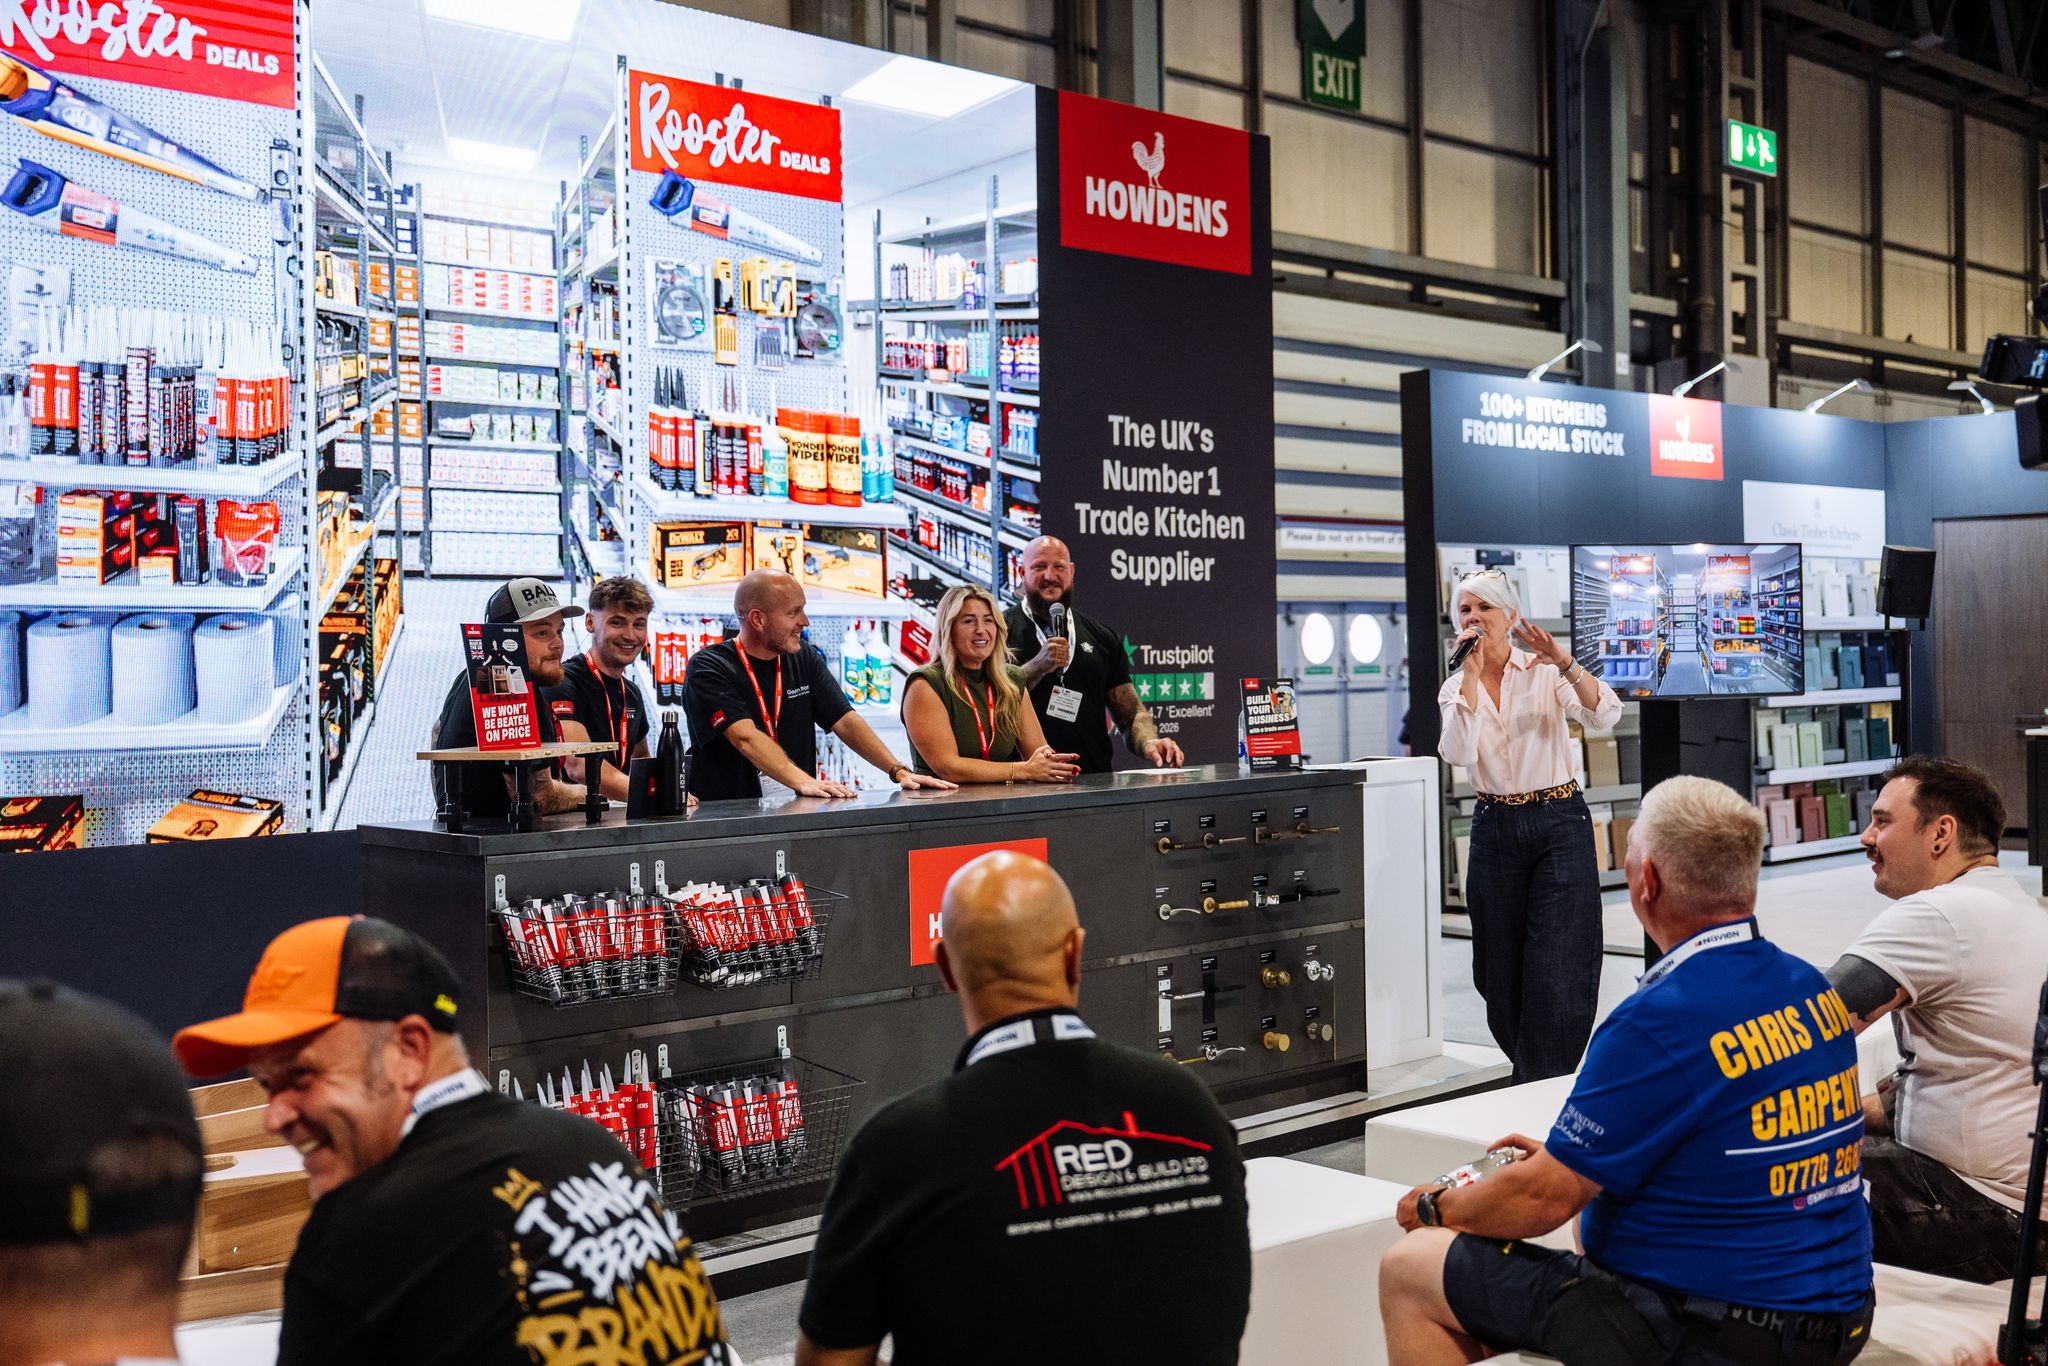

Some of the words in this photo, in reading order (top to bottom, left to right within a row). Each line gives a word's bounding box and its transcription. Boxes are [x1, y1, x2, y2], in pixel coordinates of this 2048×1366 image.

[206, 43, 280, 76] DEALS
[1312, 51, 1357, 102] EXIT
[639, 81, 781, 169] Rooster
[780, 150, 831, 175] DEALS
[1085, 176, 1229, 238] HOWDENS
[1480, 391, 1524, 419] 100+
[1525, 396, 1607, 429] KITCHENS
[1108, 414, 1157, 449] The
[1160, 421, 1214, 453] UK's
[1462, 418, 1513, 448] FROM
[1515, 424, 1570, 452] LOCAL
[1571, 429, 1625, 457] STOCK
[1659, 439, 1715, 463] HOWDENS
[792, 450, 825, 462] WIPES
[1102, 459, 1204, 496] Number
[1207, 467, 1221, 496] 1
[1075, 503, 1150, 537] Trade
[1154, 505, 1245, 541] Kitchen
[1286, 530, 1313, 542] Please
[1316, 532, 1326, 542] do
[1329, 533, 1341, 543] not
[1357, 534, 1364, 543] in
[1367, 533, 1385, 543] front
[1388, 535, 1395, 544] of
[1772, 522, 1800, 538] Classic
[1829, 526, 1861, 541] Kitchens
[1111, 548, 1215, 587] Supplier
[1140, 644, 1214, 669] Trustpilot
[482, 706, 497, 719] WE
[498, 702, 528, 717] WON'T
[1246, 694, 1271, 705] BUILD
[1247, 704, 1271, 715] YOUR
[484, 718, 496, 730] BE
[497, 714, 530, 729] BEATEN
[485, 729, 500, 743] ON
[502, 725, 531, 741] PRICE
[1159, 722, 1180, 734] 2026
[1248, 713, 1290, 726] BUSINESS
[1709, 1005, 1813, 1079] CHRIS
[1054, 1139, 1133, 1174] RED
[1060, 1169, 1124, 1192] DESIGN
[1137, 1159, 1182, 1181] BUILD
[1182, 1155, 1209, 1174] LTD
[1769, 1152, 1829, 1197] 07770
[514, 1197, 576, 1257] I
[551, 1161, 652, 1235] HAVE
[562, 1206, 684, 1299] BEEN
